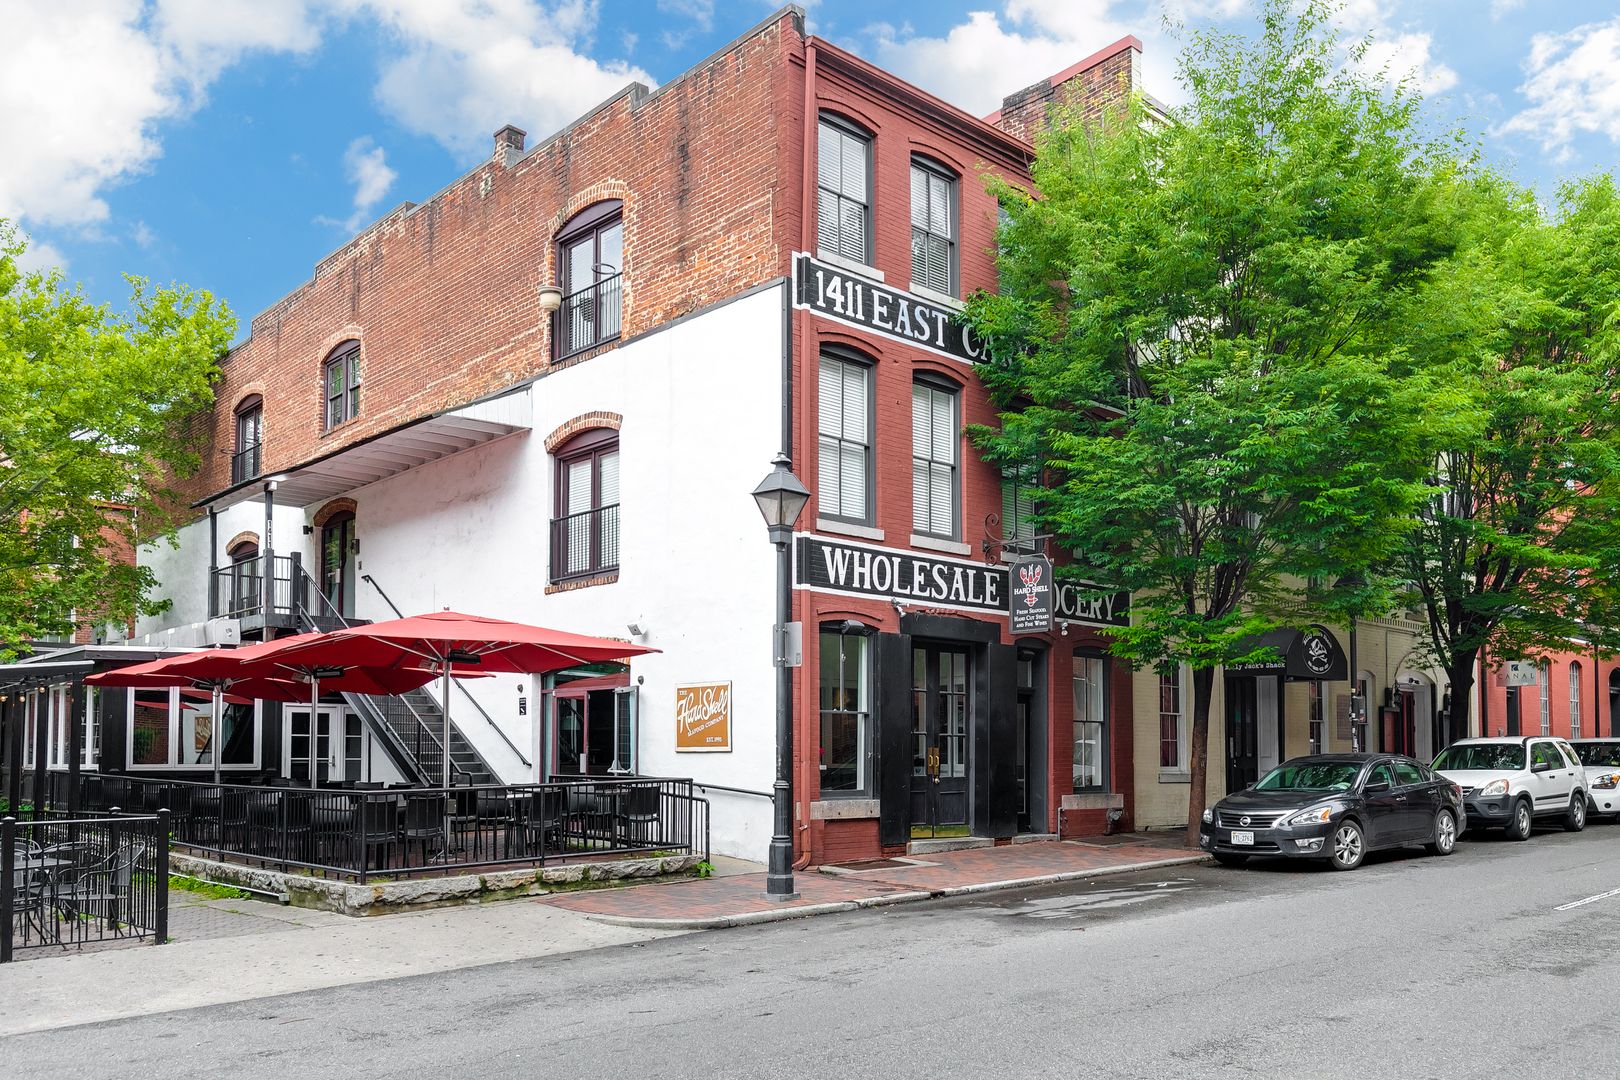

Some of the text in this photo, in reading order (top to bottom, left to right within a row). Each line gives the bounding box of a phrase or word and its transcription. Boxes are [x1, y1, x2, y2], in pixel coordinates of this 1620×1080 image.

[815, 270, 865, 320] 1411
[871, 288, 949, 347] EAST
[821, 545, 1000, 606] WHOLESALE
[1032, 585, 1048, 593] SHELL
[702, 686, 728, 720] Shell
